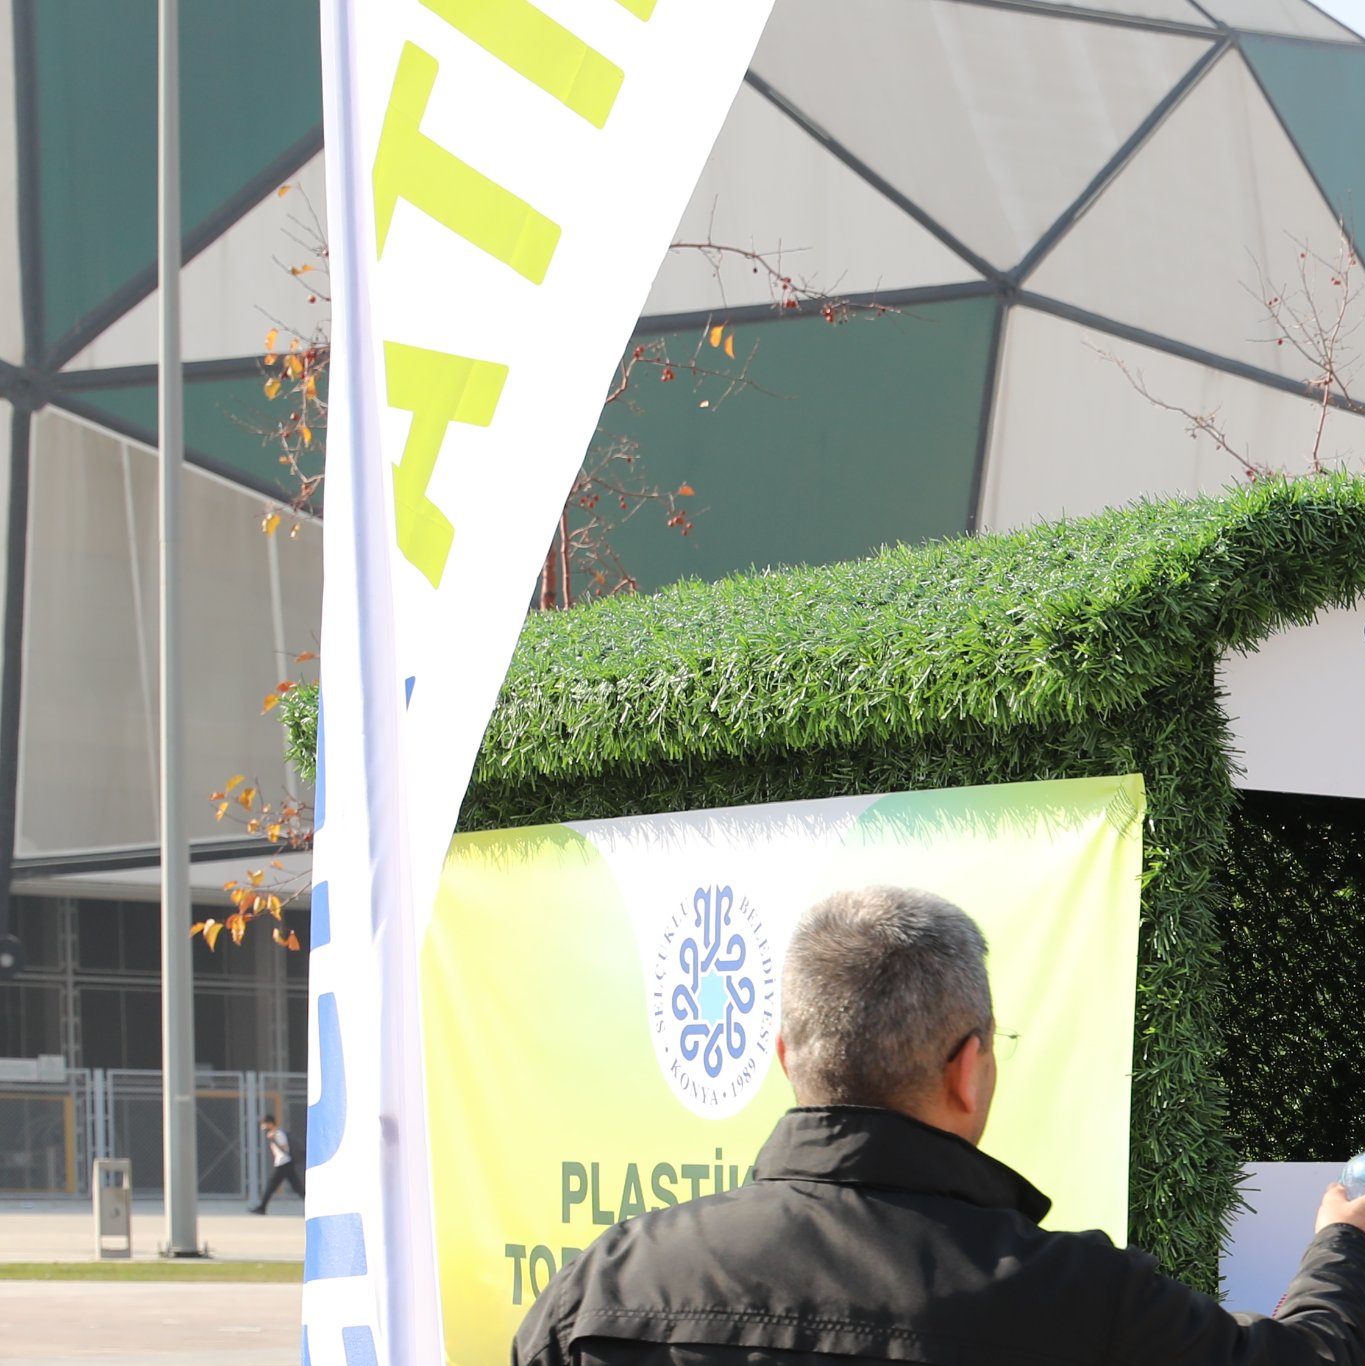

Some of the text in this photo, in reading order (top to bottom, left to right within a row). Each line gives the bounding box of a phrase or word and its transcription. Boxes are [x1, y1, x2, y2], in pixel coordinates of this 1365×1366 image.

[738, 896, 777, 1055] BELEDİYESİ
[670, 1057, 757, 1106] KONYA 1989
